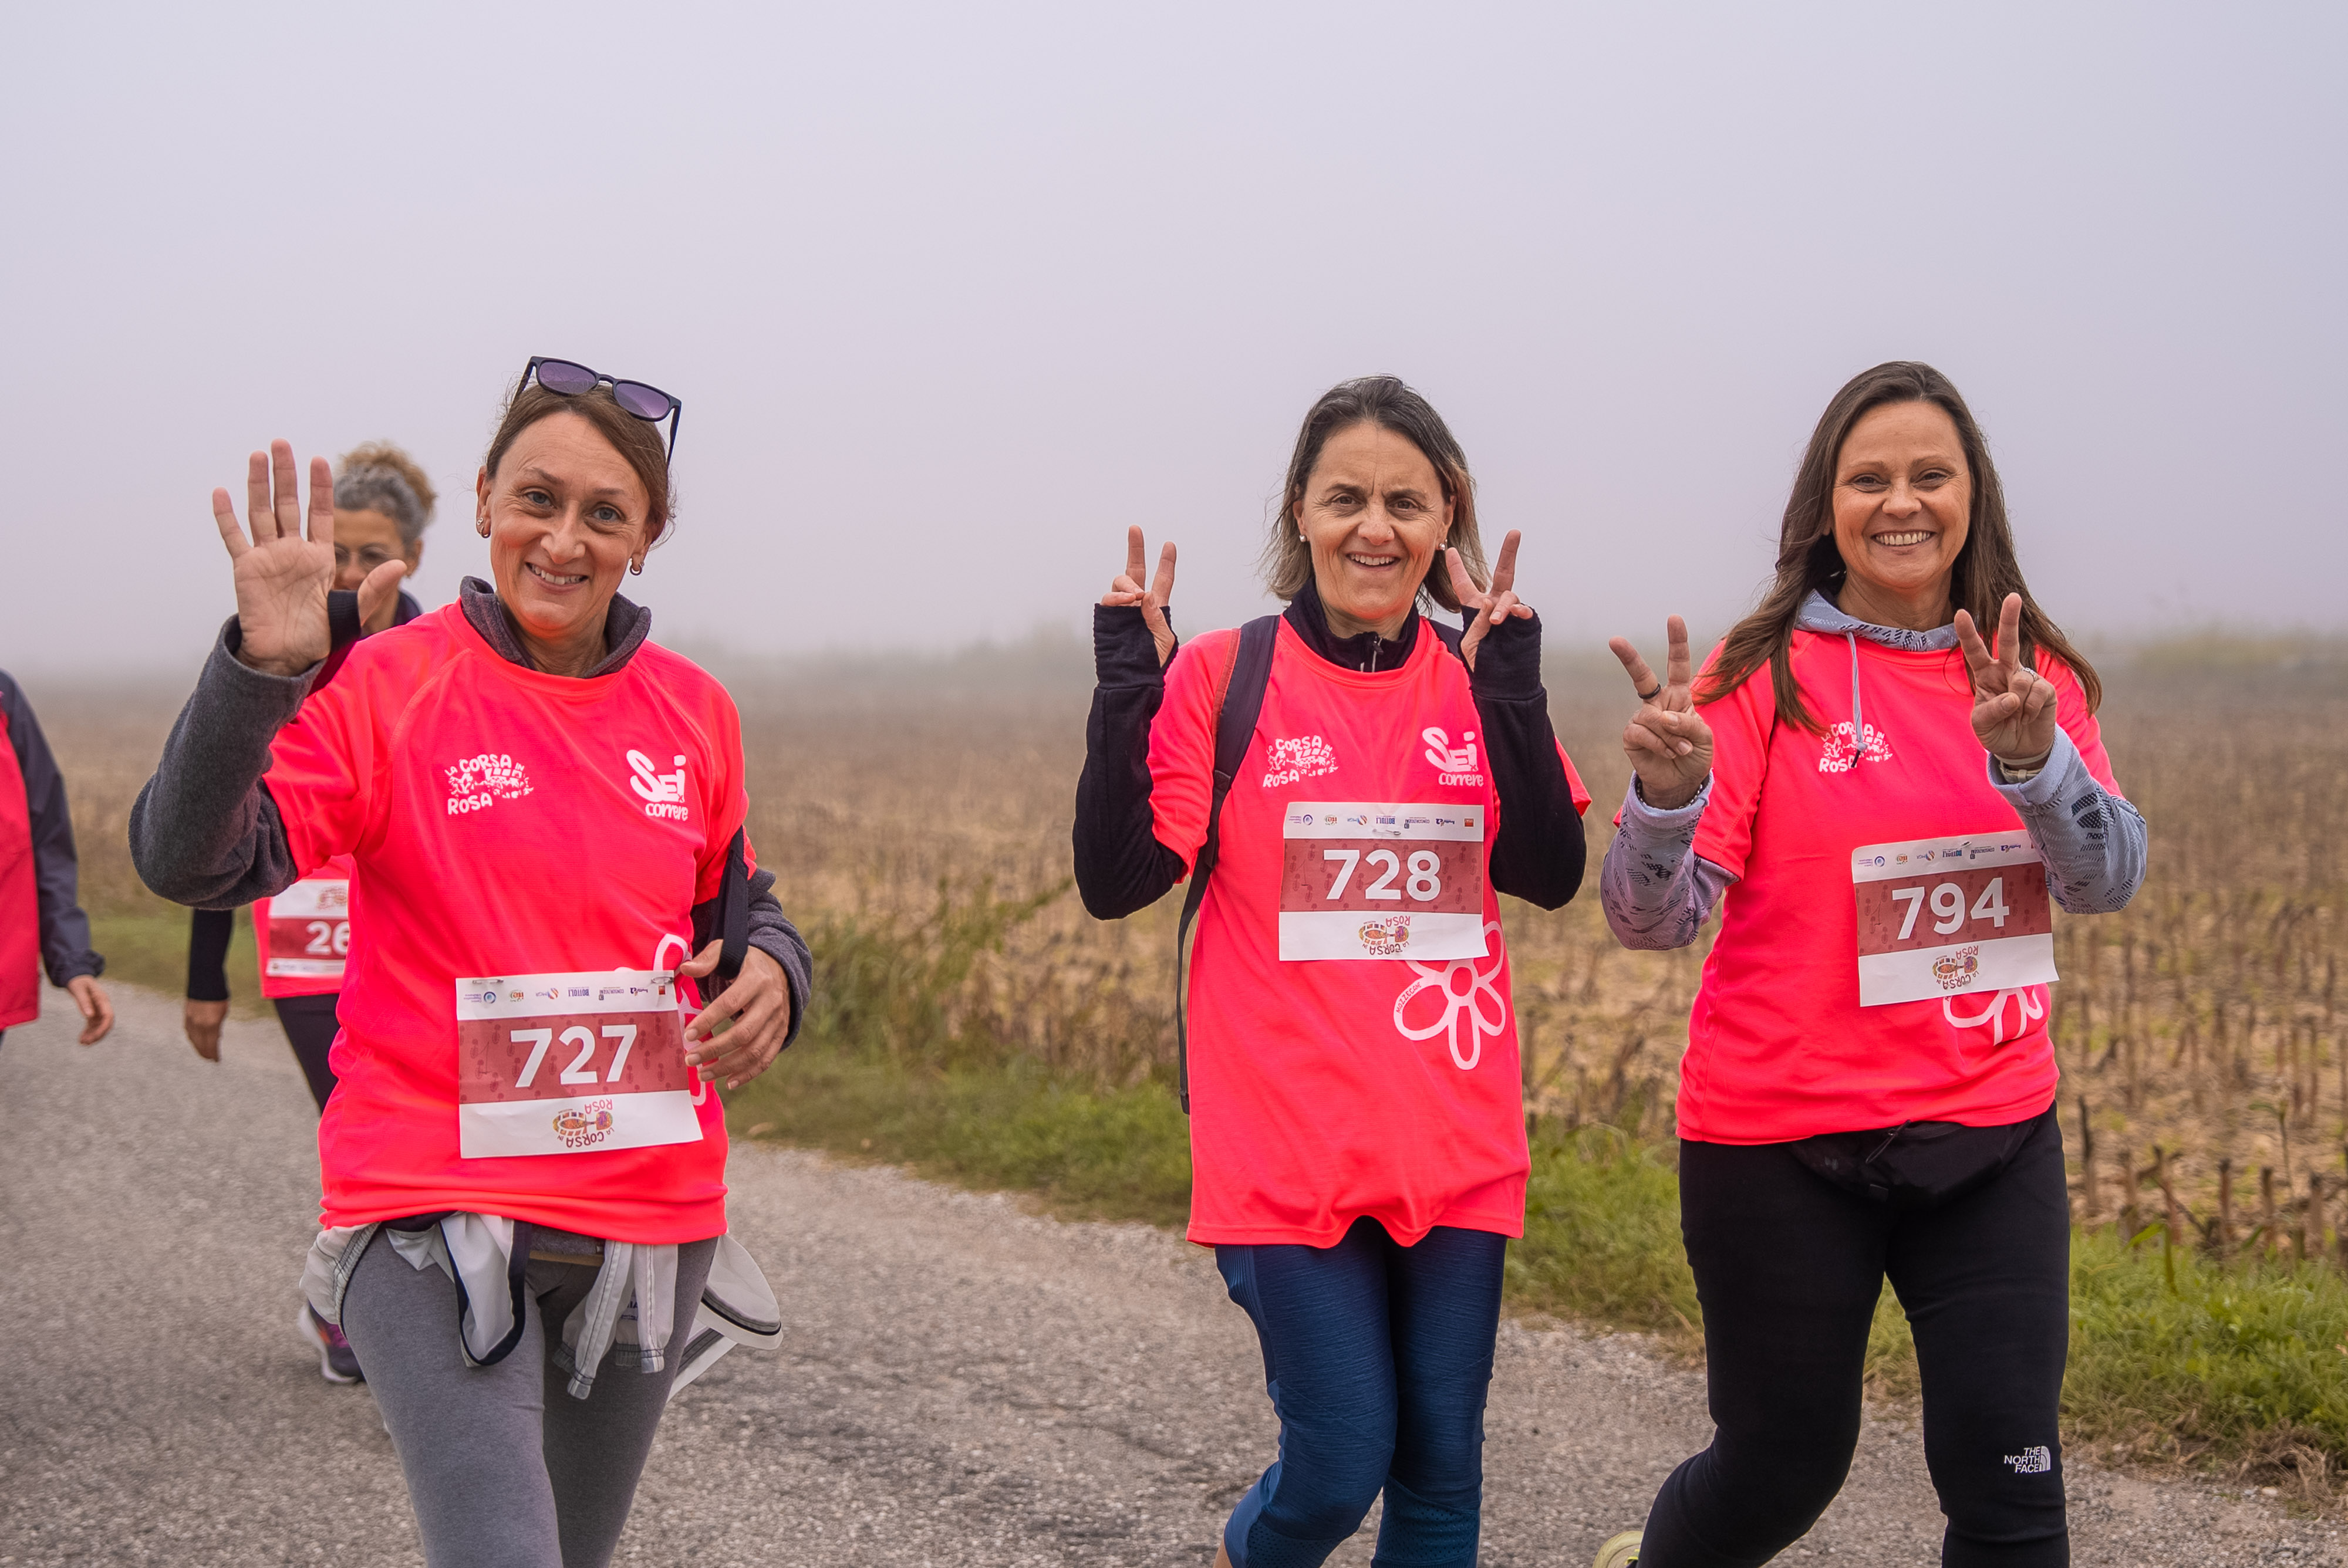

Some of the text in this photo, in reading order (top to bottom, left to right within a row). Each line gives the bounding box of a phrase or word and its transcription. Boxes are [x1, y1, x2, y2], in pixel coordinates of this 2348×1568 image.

[1820, 721, 1885, 742] LA CORA IN
[1275, 735, 1322, 752] CORSA
[444, 753, 525, 776] LA CORSA IN
[1263, 769, 1300, 788] ROSA
[1438, 773, 1484, 787] correre
[447, 792, 492, 815] ROSA
[645, 803, 689, 822] correre
[1323, 849, 1441, 901] 728
[1891, 877, 2009, 940] 794
[1385, 915, 1411, 928] ROSA
[1955, 945, 1979, 960] ROSA
[510, 1024, 637, 1087] 727
[584, 1099, 613, 1114] ROSA
[566, 1131, 605, 1148] CORSA
[606, 1127, 615, 1135] LA
[2003, 1455, 2040, 1464] NORTH
[2023, 1446, 2040, 1456] THE
[2015, 1464, 2039, 1474] FACE
